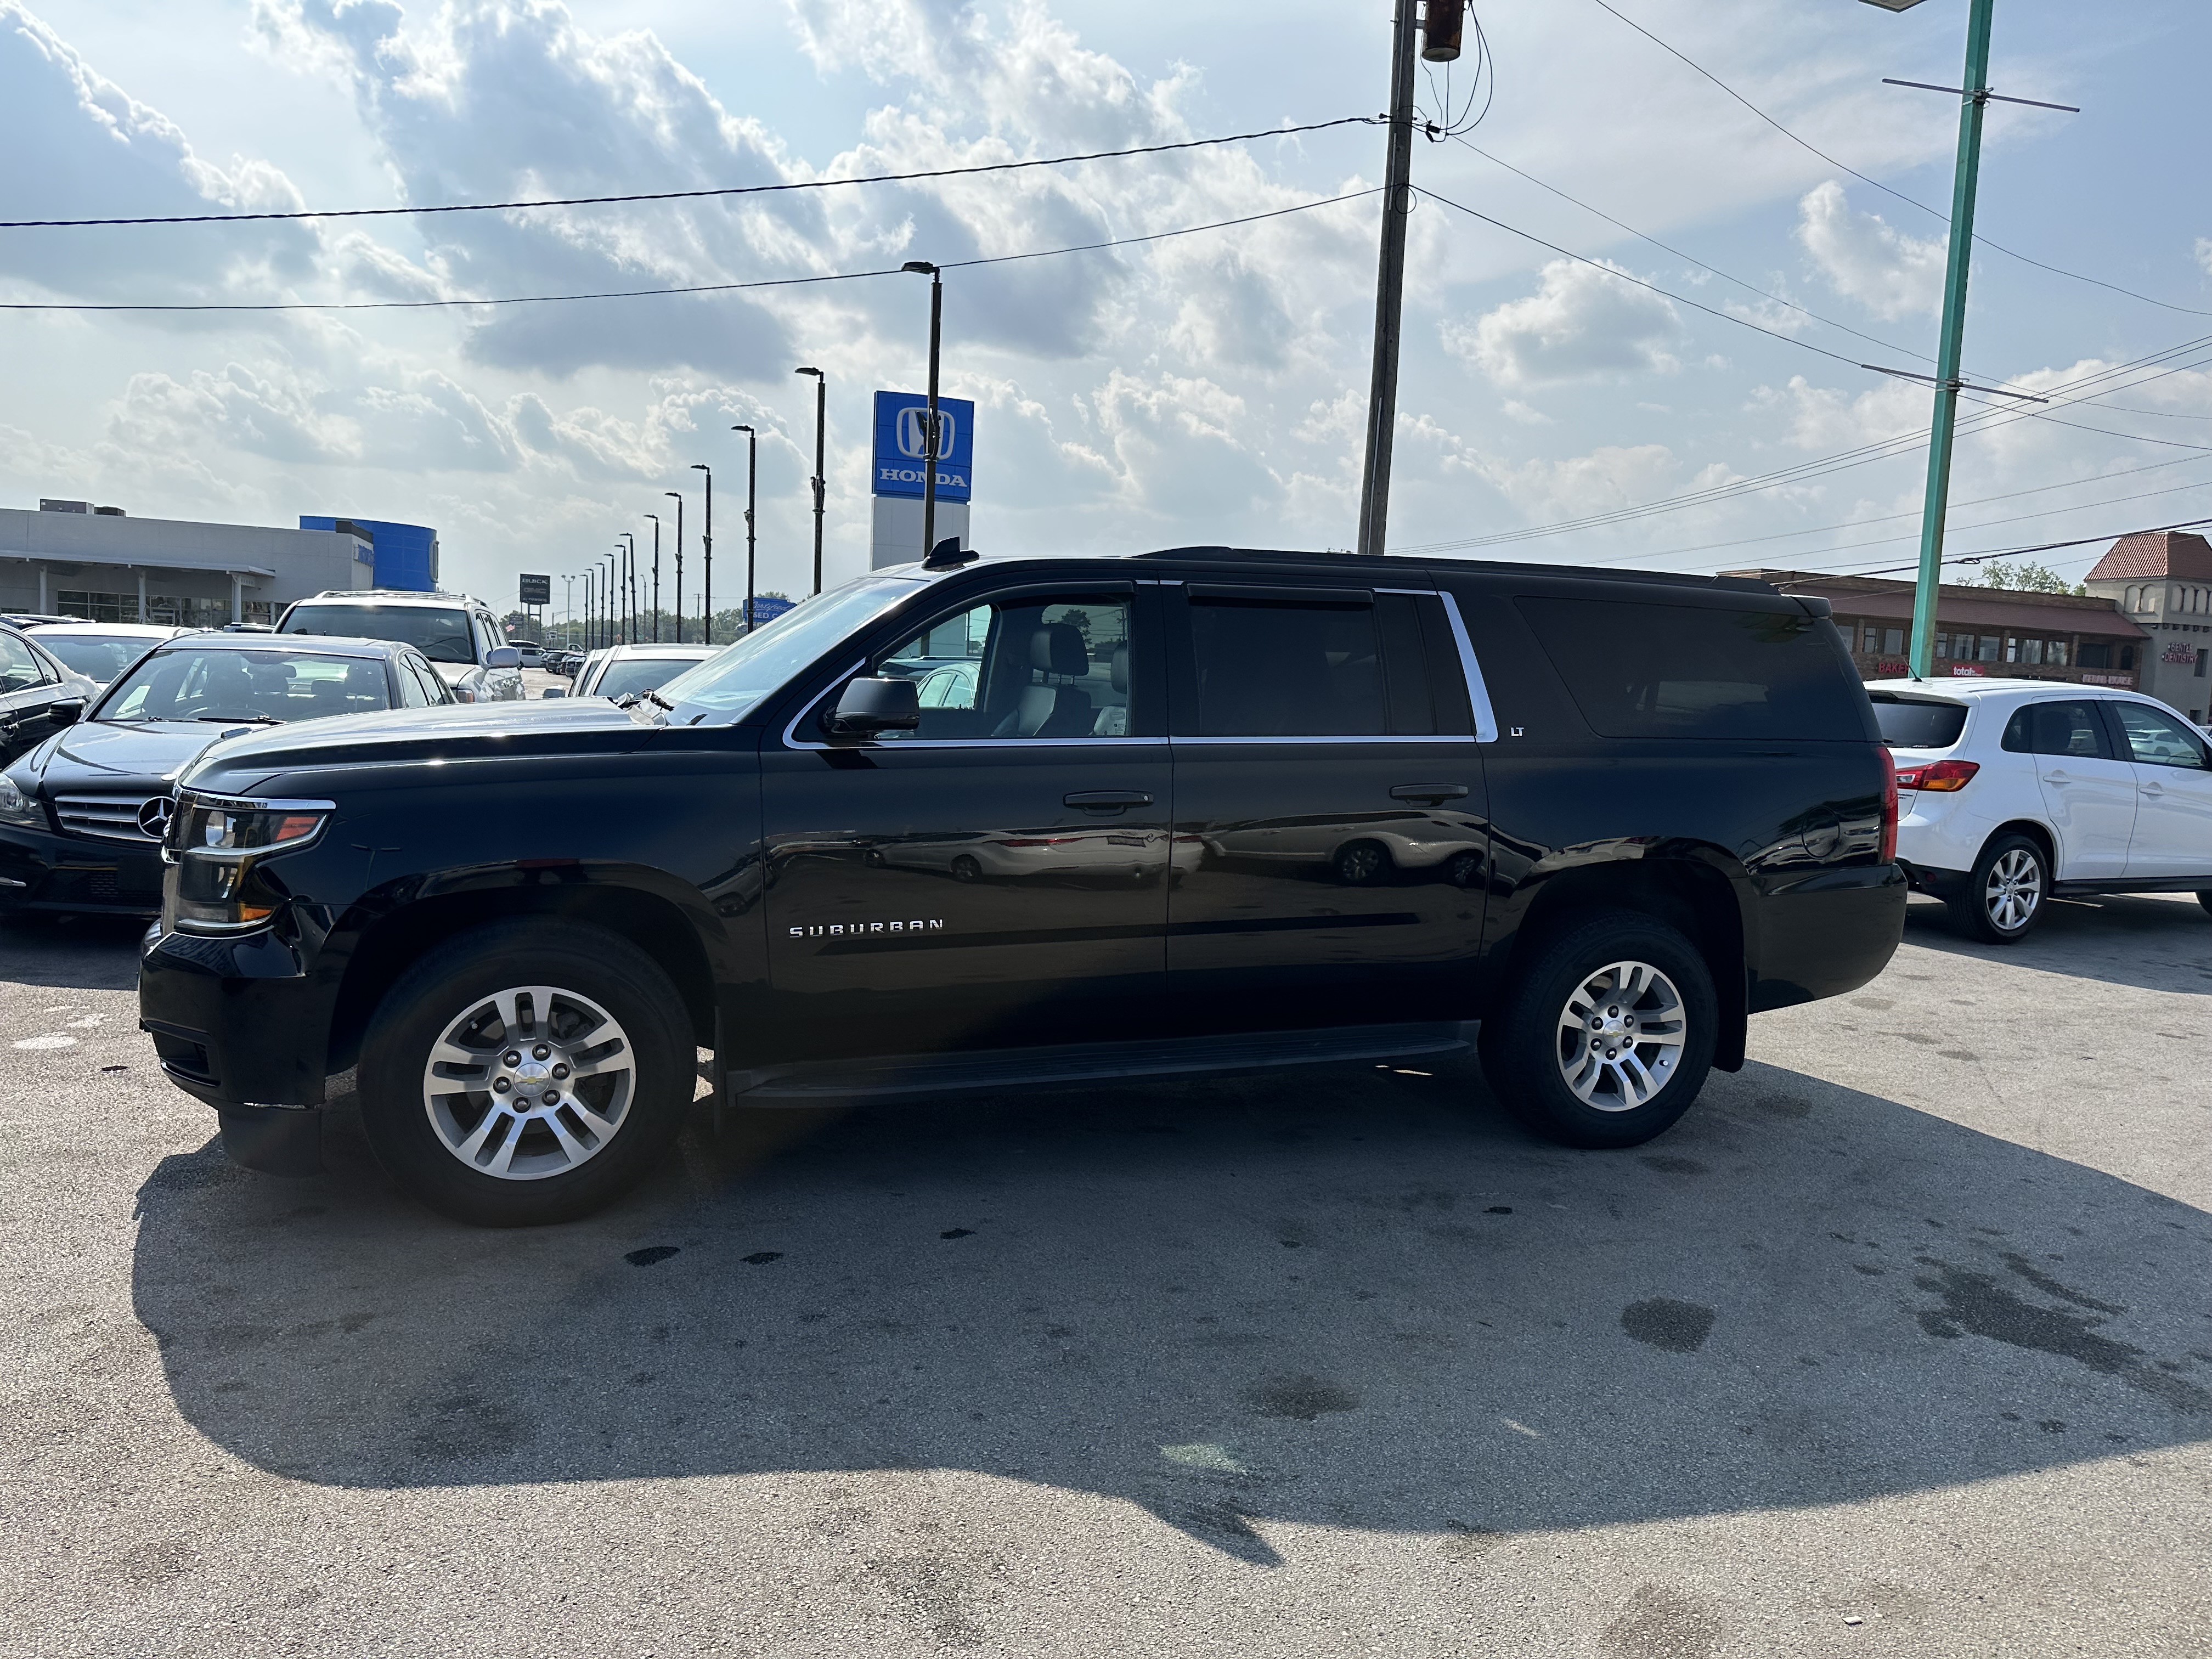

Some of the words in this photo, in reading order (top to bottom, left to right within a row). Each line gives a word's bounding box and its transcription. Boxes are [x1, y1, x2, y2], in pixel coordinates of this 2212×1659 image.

[2171, 642, 2193, 653] GENTLE
[2164, 652, 2198, 664] DENTISTRY
[1954, 666, 1972, 676] total
[1510, 727, 1525, 736] LT
[789, 919, 943, 938] SUBURBAN
